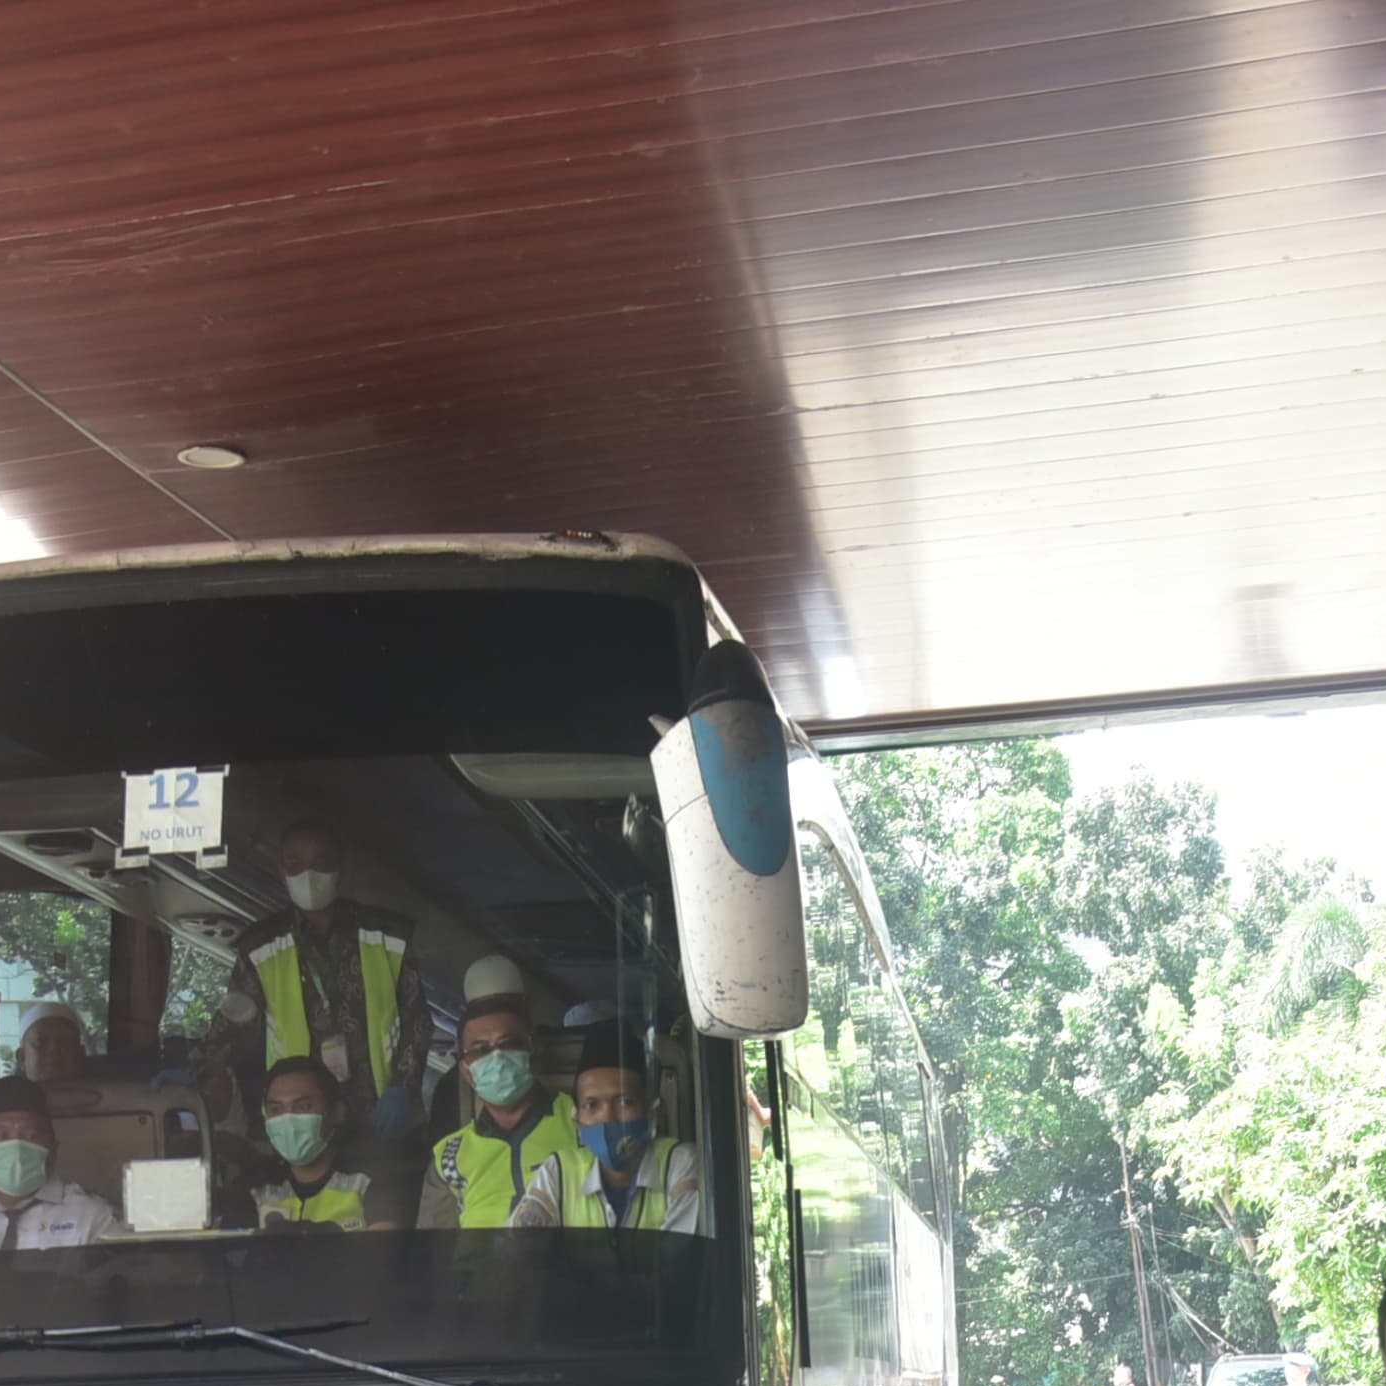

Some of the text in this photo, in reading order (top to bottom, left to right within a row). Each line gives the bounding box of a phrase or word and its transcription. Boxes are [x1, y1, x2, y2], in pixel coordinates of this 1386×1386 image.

[148, 772, 200, 810] 12
[140, 825, 205, 841] NO URUT
